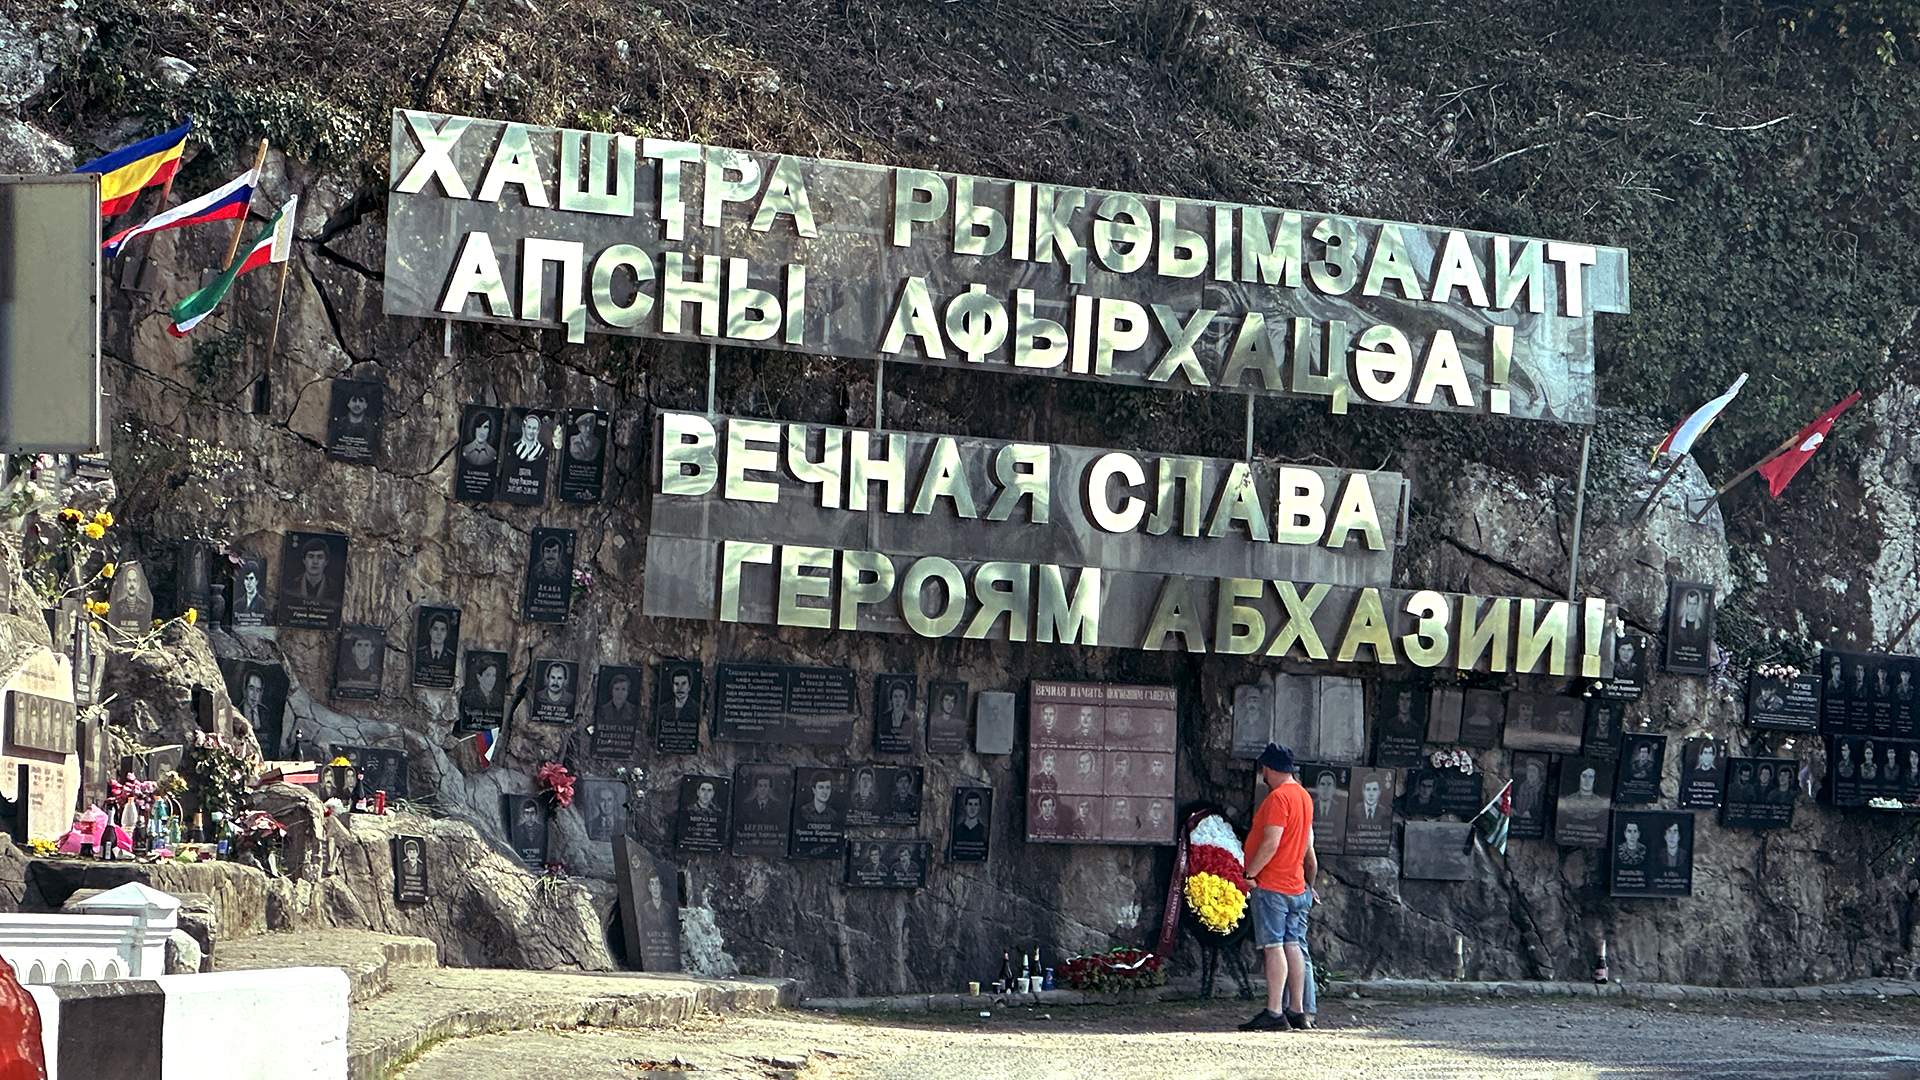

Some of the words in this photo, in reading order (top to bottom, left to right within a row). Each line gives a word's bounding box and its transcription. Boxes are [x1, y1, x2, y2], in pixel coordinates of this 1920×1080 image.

[661, 412, 1051, 524] ВЕЧНАЯ
[1087, 452, 1386, 551] СЛАВА
[719, 540, 1101, 647] ГЕРОЯМ
[1142, 577, 1606, 678] АБХАЗИИ!
[1035, 684, 1067, 697] ВЕЧНАЯ
[1070, 687, 1104, 699] ПАМЯТЬ
